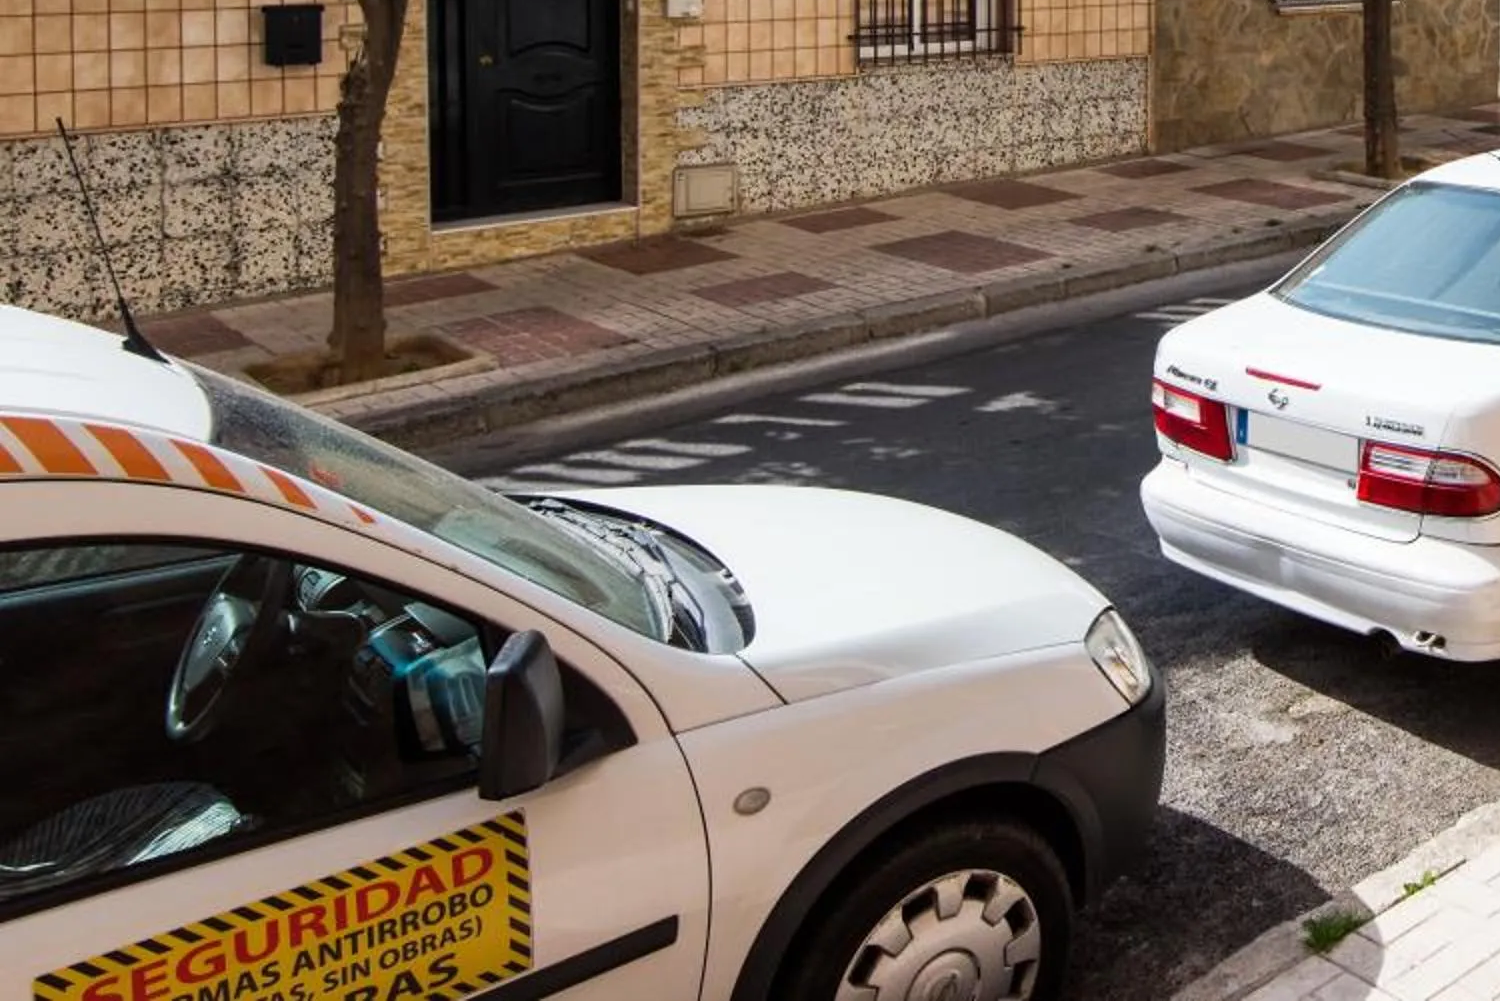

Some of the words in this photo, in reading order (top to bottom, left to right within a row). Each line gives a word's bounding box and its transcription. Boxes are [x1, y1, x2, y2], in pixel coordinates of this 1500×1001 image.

[82, 846, 494, 1001] SEGURIDAD
[171, 960, 281, 1001] MAS
[292, 883, 494, 977] ANTIRROBO
[323, 957, 371, 994] SIN
[378, 914, 483, 970] OBRAS)
